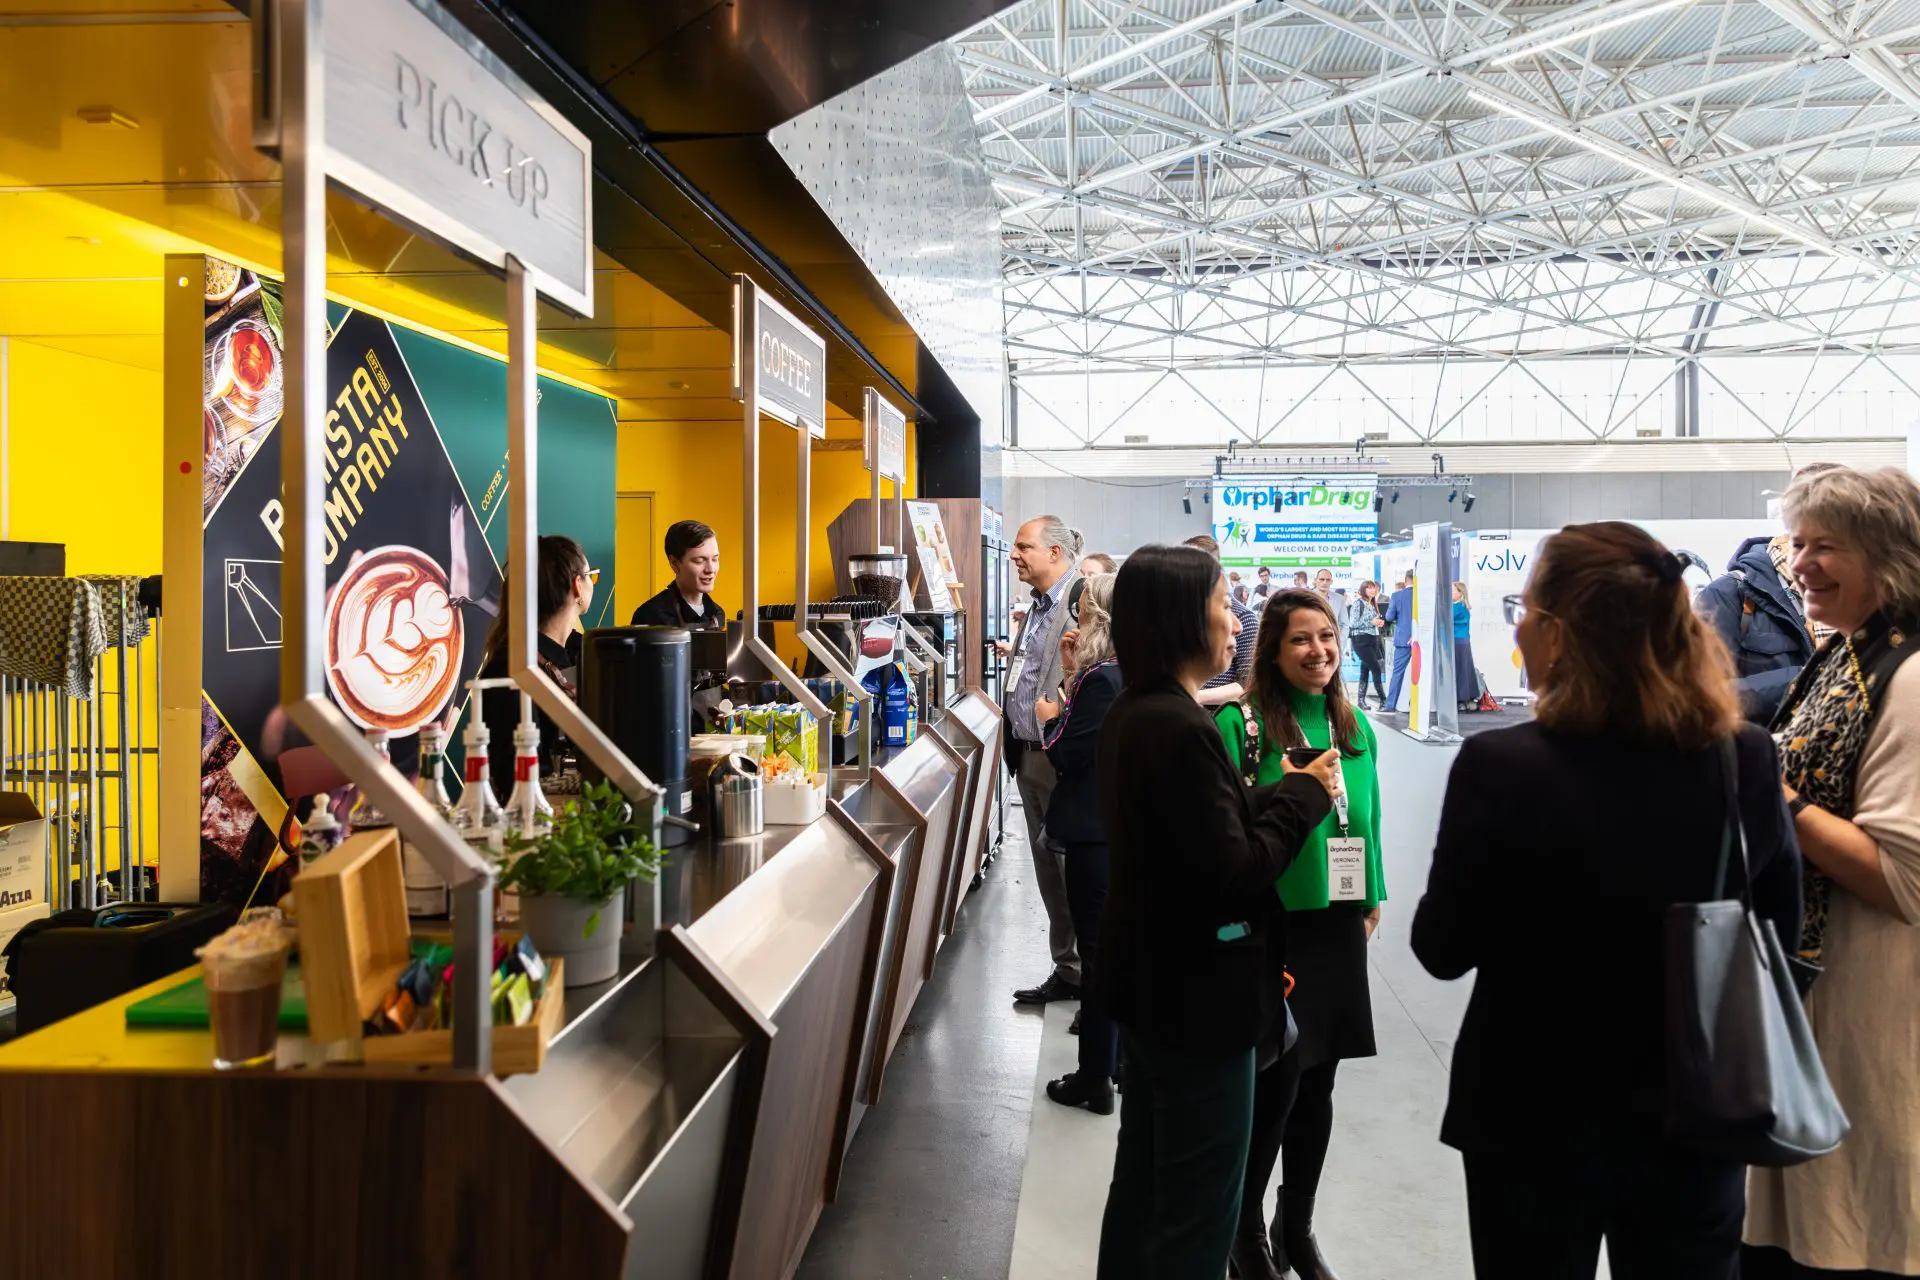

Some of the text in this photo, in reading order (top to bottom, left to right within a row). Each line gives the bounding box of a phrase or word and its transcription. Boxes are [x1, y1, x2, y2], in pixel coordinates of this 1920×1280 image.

[394, 52, 549, 219] PICK UP
[761, 331, 811, 398] COFFEE
[324, 393, 409, 564] OMPANY
[481, 469, 502, 511] COFFEE
[1477, 549, 1526, 571] volv
